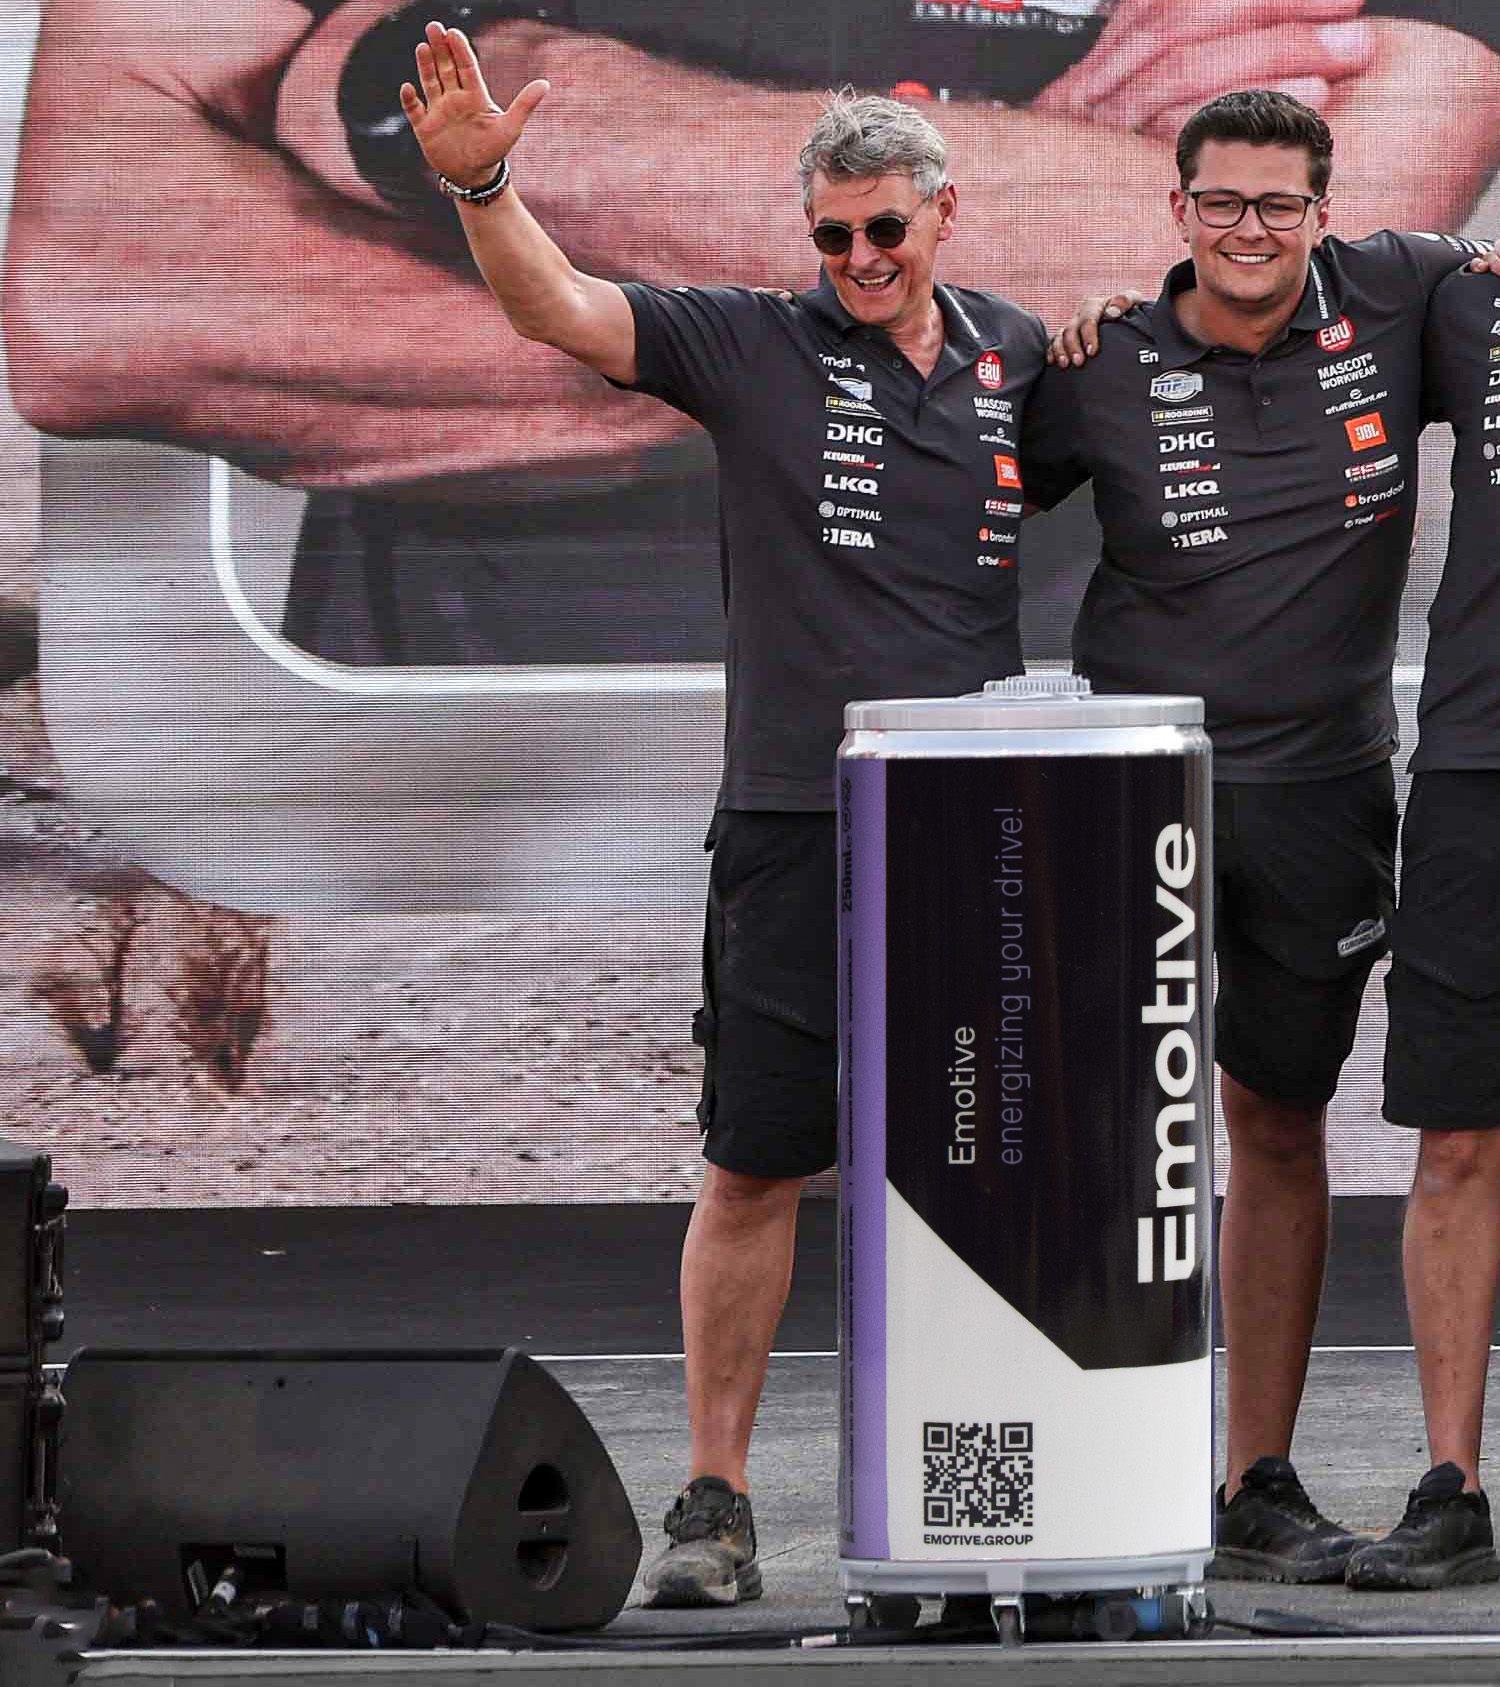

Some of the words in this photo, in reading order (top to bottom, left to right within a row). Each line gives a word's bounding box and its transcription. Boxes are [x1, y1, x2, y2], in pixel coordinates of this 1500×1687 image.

[1319, 319, 1351, 346] ERU
[977, 362, 1001, 381] ERU
[1320, 363, 1378, 391] WORKWEAR
[1164, 407, 1210, 420] ROORDINK
[826, 422, 884, 447] DHG
[1158, 430, 1216, 454] DHG
[1354, 422, 1381, 442] JBL
[823, 450, 866, 464] KEUKEN
[1159, 459, 1200, 473] KEUKEN
[823, 473, 879, 496] LKQ
[1163, 479, 1221, 500] LKQ
[836, 505, 883, 522] OPTIMAL
[1179, 506, 1230, 524] OPTIMAL
[992, 806, 1024, 899] drive!
[1000, 909, 1031, 983] your
[1137, 821, 1197, 1285] Emotive
[993, 991, 1032, 1167] energizing
[947, 1024, 977, 1167] Emotive
[922, 1533, 1035, 1547] EMOTIVE.GROUP
